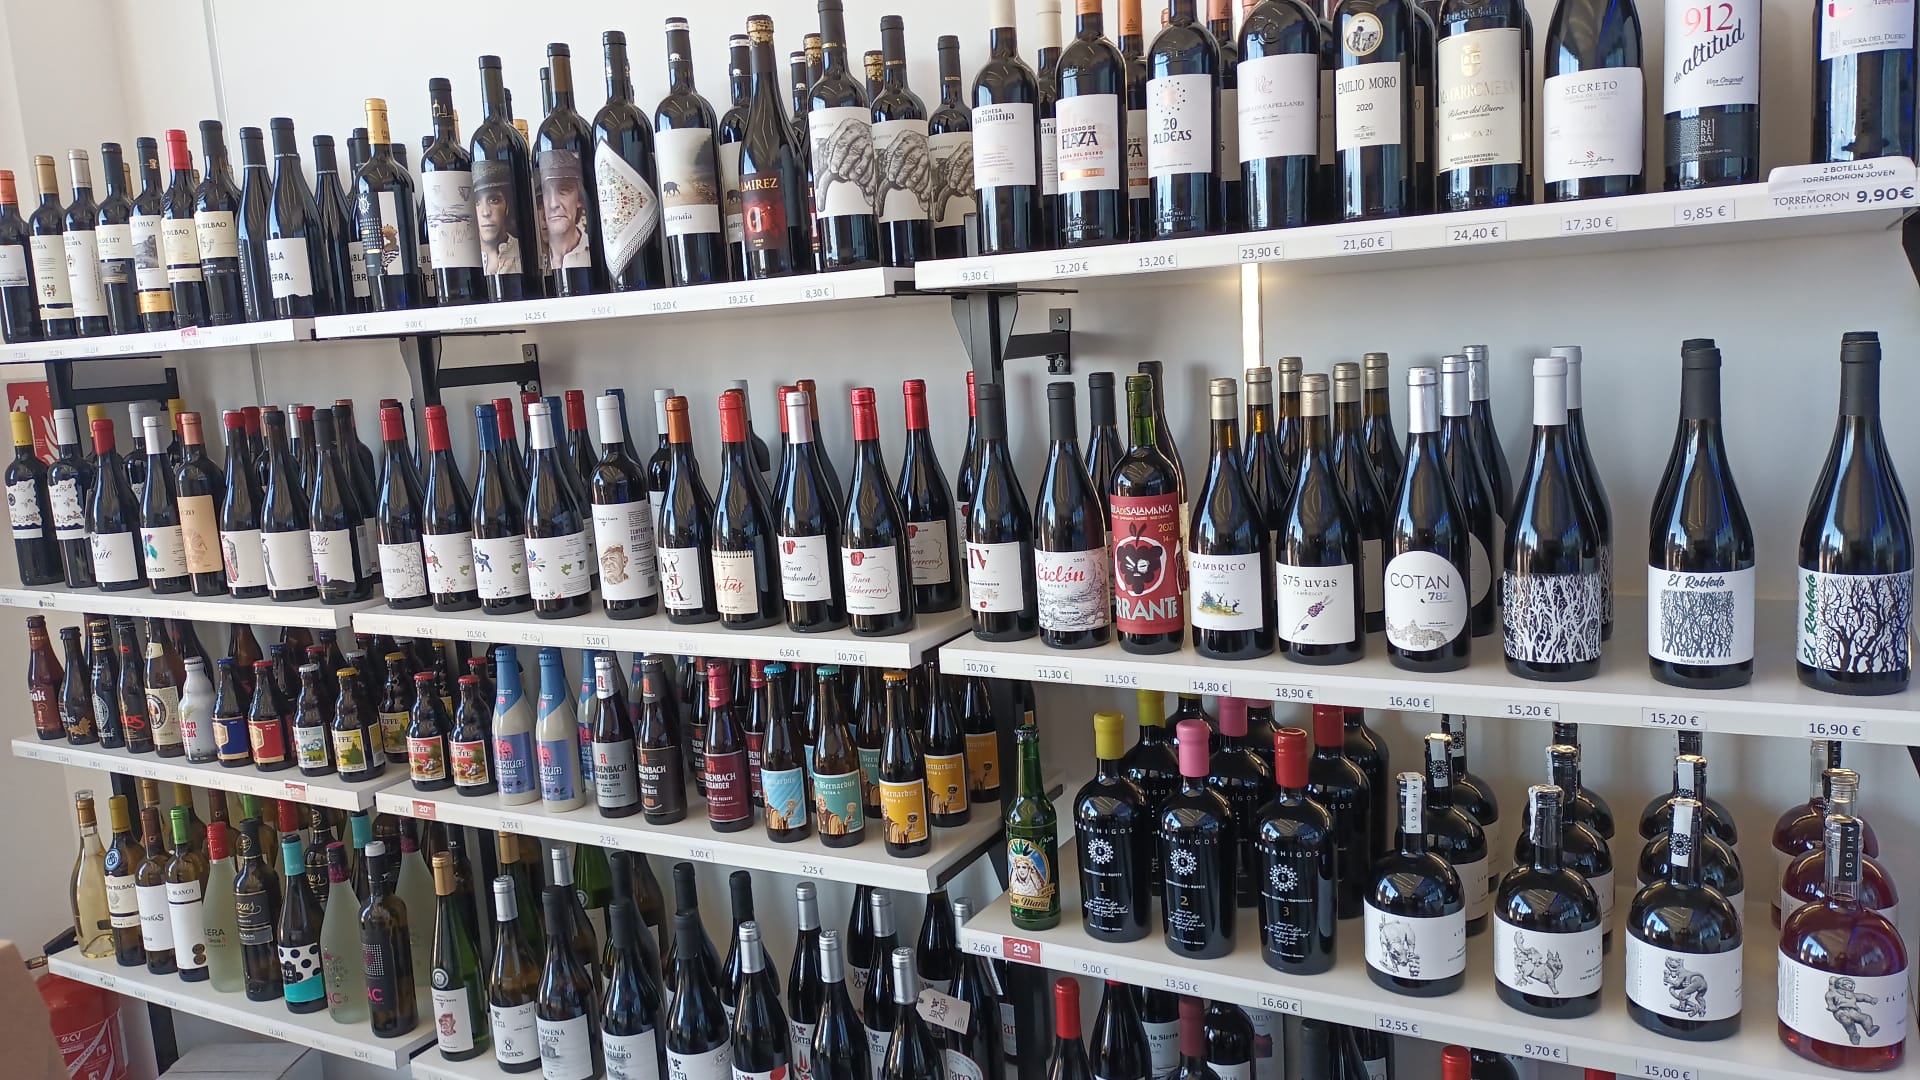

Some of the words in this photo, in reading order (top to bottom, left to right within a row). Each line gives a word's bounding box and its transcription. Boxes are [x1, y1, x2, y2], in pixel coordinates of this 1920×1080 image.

[1684, 3, 1733, 36] 912
[1674, 71, 1682, 85] de
[1683, 18, 1745, 75] altitud
[1338, 79, 1365, 95] EMILIO
[1369, 76, 1397, 90] MORO
[1565, 81, 1618, 95] SECRETO
[1356, 102, 1374, 112] 2020
[1163, 118, 1178, 130] 20
[1062, 131, 1099, 150] HAZA
[1153, 130, 1192, 145] ALDEAS
[1831, 163, 1874, 173] BOTELLAS
[1865, 169, 1896, 179] JOVEN
[1683, 207, 1713, 221] 9,85
[1716, 205, 1726, 217] €
[1566, 218, 1601, 233] 17,30
[1604, 216, 1613, 228] €
[1454, 228, 1488, 243] 24,40
[1490, 227, 1499, 238] €
[1343, 237, 1374, 250] 21,60
[1376, 236, 1384, 247] €
[1242, 247, 1272, 259] 23,90
[1273, 246, 1281, 256] €
[1055, 263, 1080, 274] 12,20
[1082, 261, 1089, 271] €
[1139, 256, 1165, 268] 13,20
[1167, 255, 1174, 265] €
[962, 271, 981, 281] 9,30
[982, 270, 989, 280] €
[806, 288, 821, 299] 8,30
[822, 287, 829, 297] €
[728, 294, 748, 305] 19,25
[749, 294, 755, 304] €
[653, 302, 670, 311] 10,20
[670, 301, 677, 310] €
[524, 312, 541, 320] 14,25
[541, 311, 547, 319] €
[1037, 564, 1085, 583] Ciclón
[1304, 577, 1338, 588] uvas
[1391, 573, 1450, 590] COTAN
[1668, 574, 1680, 586] El
[1685, 574, 1725, 588] Robledo
[586, 637, 600, 645] 5,10
[600, 637, 606, 645] €
[779, 649, 796, 657] 6,60
[796, 649, 801, 657] €
[837, 652, 857, 662] 10,70
[858, 654, 864, 662] €
[966, 663, 988, 673] 10,70
[990, 665, 996, 673] €
[1037, 669, 1062, 680] 11,30
[1063, 671, 1069, 679] €
[1105, 674, 1130, 685] 11,50
[1131, 676, 1137, 685] €
[1193, 681, 1220, 693] 14,80
[1222, 683, 1228, 692] €
[1276, 688, 1305, 699] 18,90
[1307, 690, 1313, 698] €
[1389, 697, 1421, 709] 16,40
[1423, 698, 1431, 708] €
[1508, 705, 1541, 717] 15,20
[1544, 707, 1551, 716] €
[1650, 712, 1687, 727] 15,20
[1690, 715, 1699, 726] €
[1809, 723, 1848, 737] 16,90
[1852, 725, 1861, 736] €
[803, 865, 818, 875] 2,25
[819, 867, 824, 875] €
[1180, 896, 1188, 906] 2
[1283, 907, 1290, 916] 3
[973, 942, 991, 953] 2,60
[992, 945, 997, 954] €
[1082, 963, 1102, 974] 9,00
[1103, 966, 1109, 976] €
[1165, 978, 1191, 991] 13,50
[1192, 982, 1199, 992] €
[1262, 997, 1288, 1010] 16,60
[1291, 1002, 1298, 1012] €
[1379, 1018, 1408, 1032] 12,55
[1411, 1022, 1418, 1033] €
[1524, 1044, 1550, 1057] 9,70
[1553, 1048, 1560, 1058] €
[1644, 1065, 1680, 1079] 15,00
[1682, 1070, 1690, 1080] €
